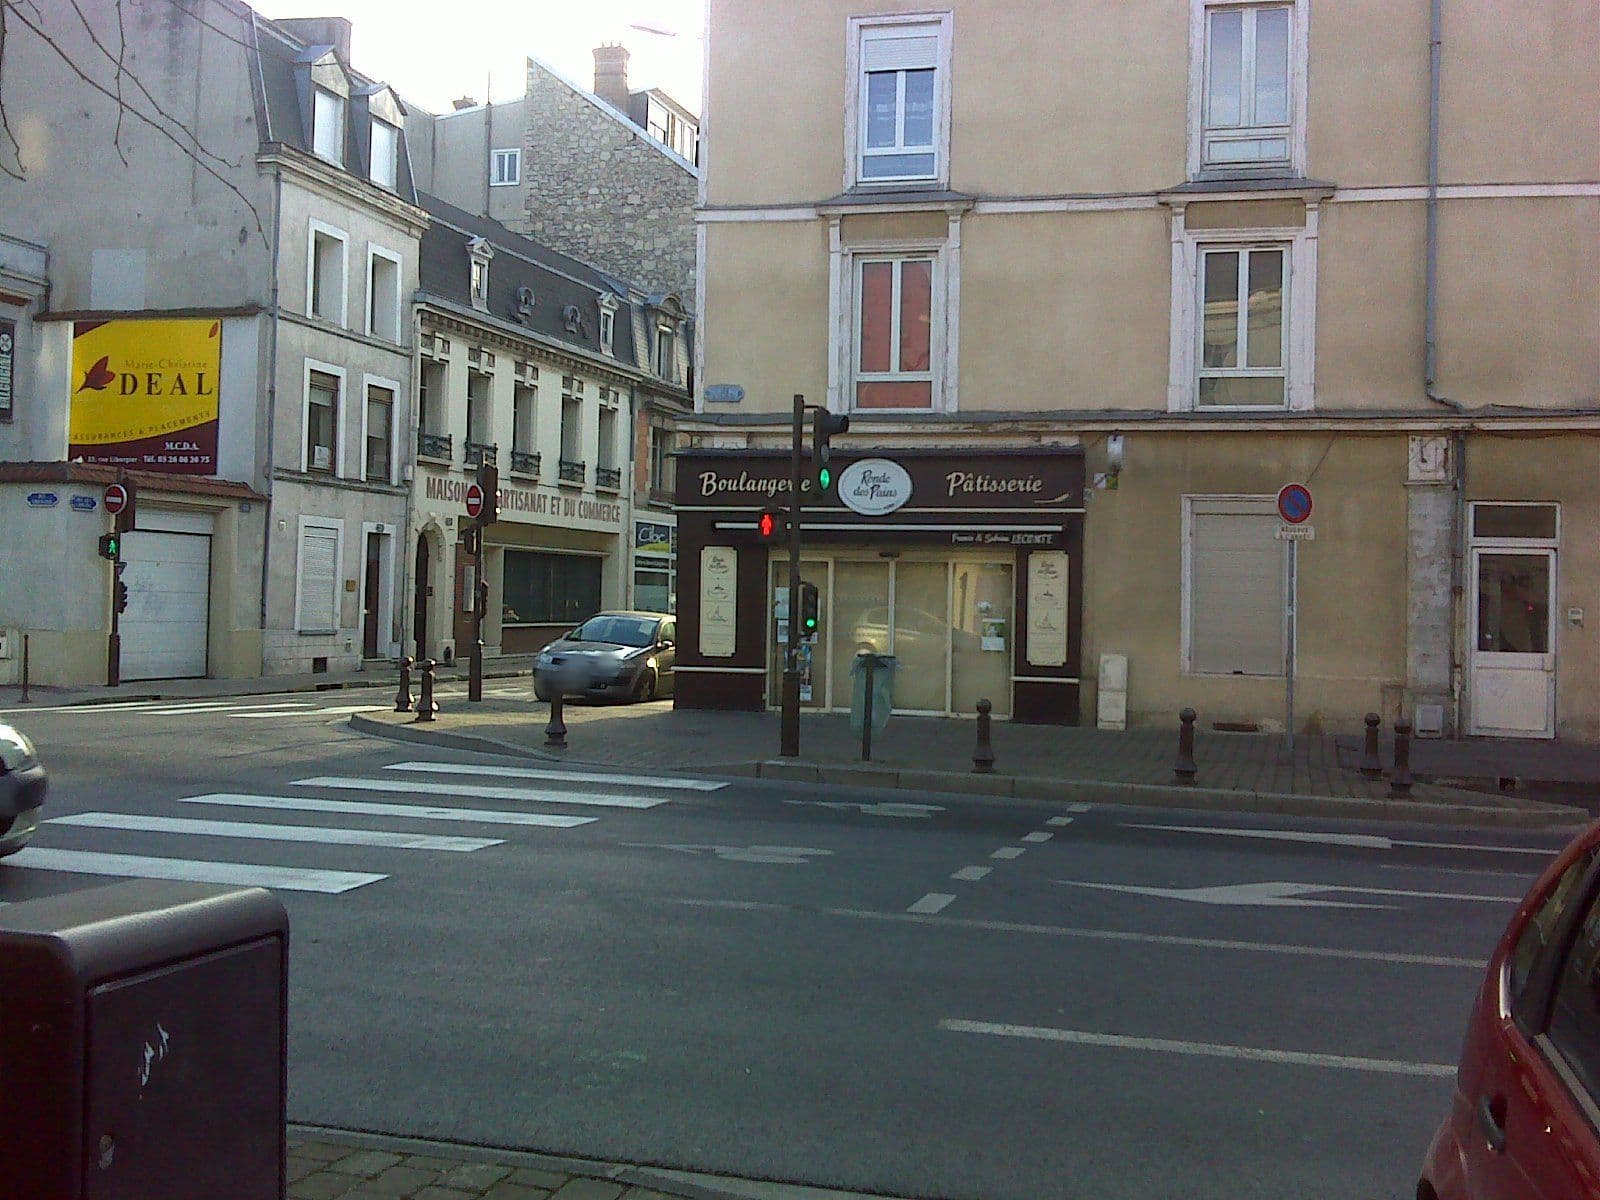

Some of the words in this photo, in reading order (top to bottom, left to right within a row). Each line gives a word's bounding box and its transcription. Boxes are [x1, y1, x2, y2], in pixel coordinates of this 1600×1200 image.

[119, 372, 213, 396] DEAL
[149, 410, 211, 433] PLACEMENTS
[699, 470, 811, 498] Boulangere
[861, 469, 891, 486] Ronde
[946, 470, 1043, 497] Pâtisserie
[426, 476, 468, 503] MAISON
[551, 496, 562, 516] ET
[563, 498, 576, 518] DU
[578, 501, 621, 524] COMMERCE
[853, 486, 869, 497] des
